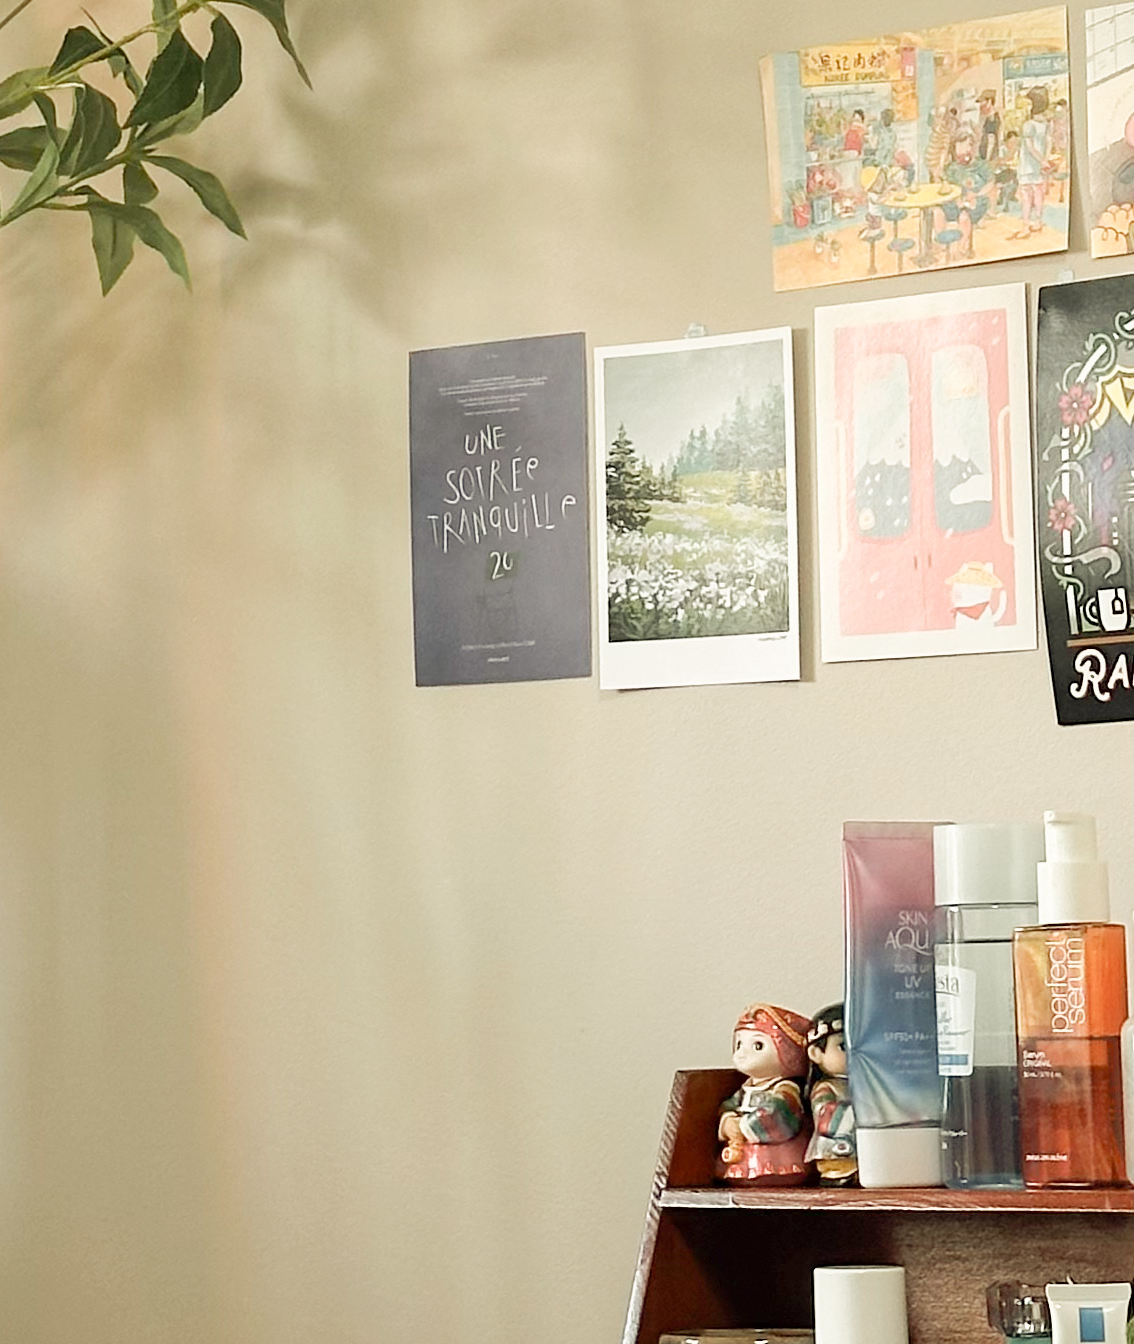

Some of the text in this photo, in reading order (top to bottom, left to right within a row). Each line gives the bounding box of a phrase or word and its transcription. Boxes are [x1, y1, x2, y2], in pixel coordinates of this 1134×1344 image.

[465, 424, 506, 455] UNE
[1070, 648, 1134, 702] RA
[898, 910, 928, 926] SKIN
[884, 926, 934, 956] AQU
[904, 976, 922, 989] UV
[936, 974, 960, 994] sta
[1045, 936, 1074, 1033] perfect
[1066, 937, 1086, 1025] serum
